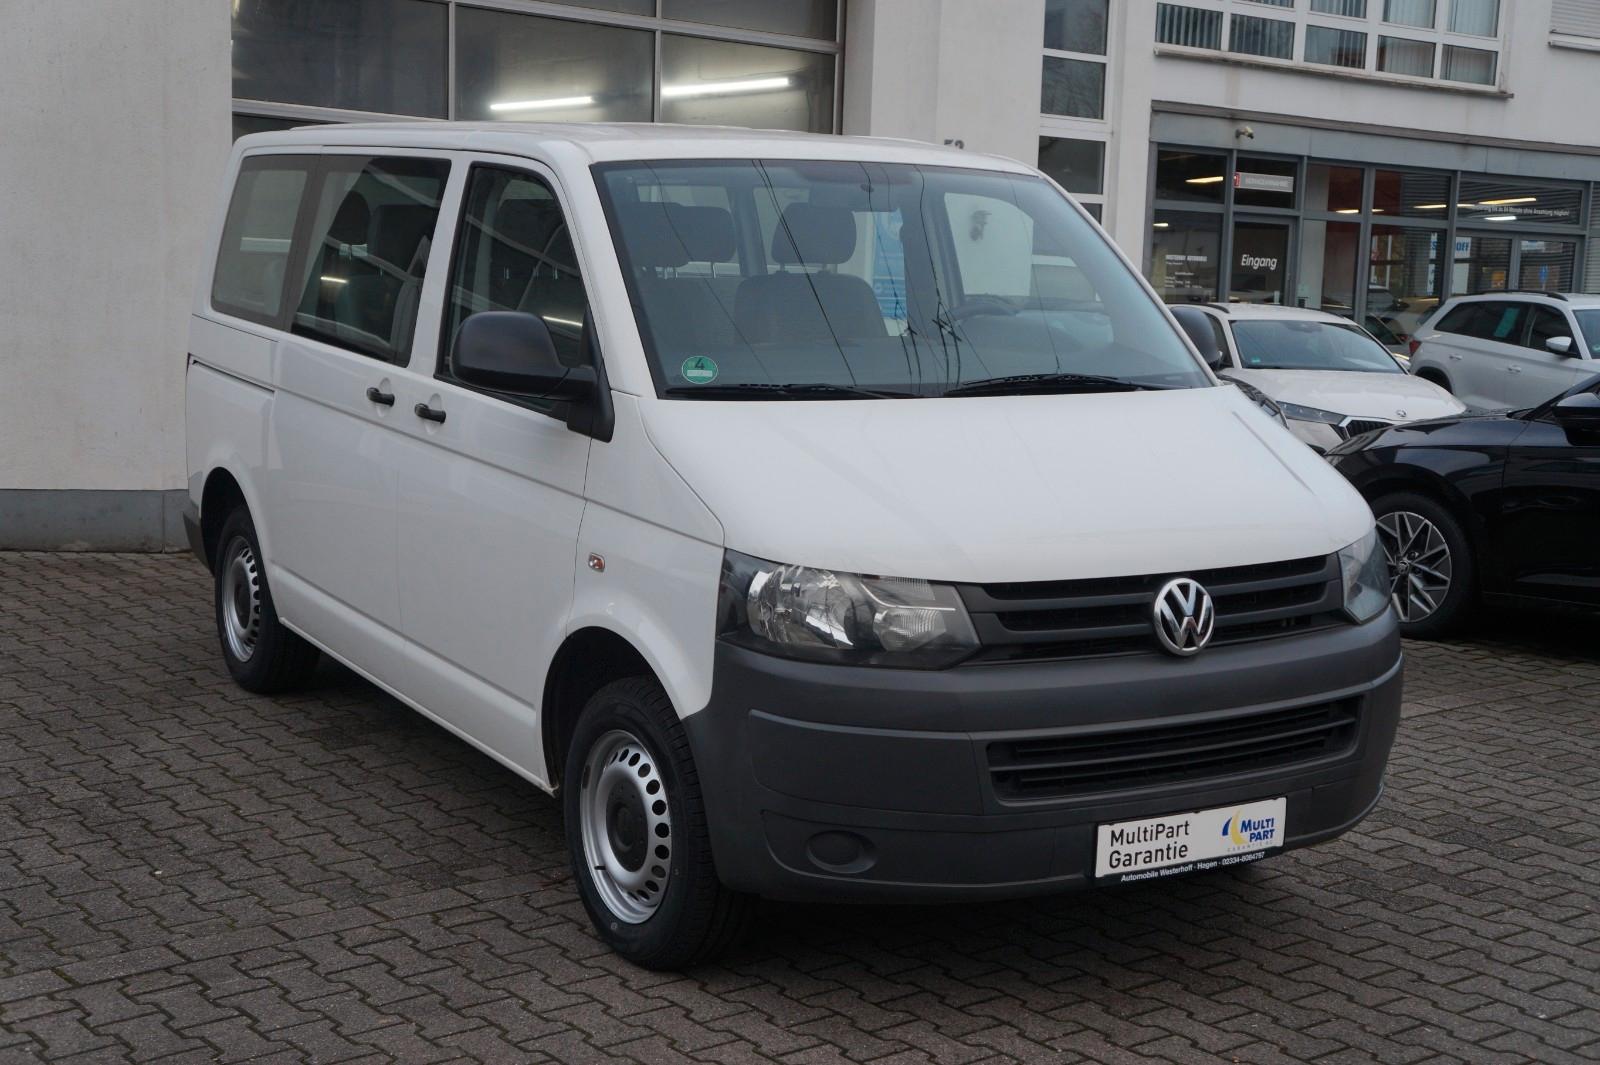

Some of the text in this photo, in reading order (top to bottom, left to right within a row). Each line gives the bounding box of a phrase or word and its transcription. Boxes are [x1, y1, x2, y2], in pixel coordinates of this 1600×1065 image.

[1241, 254, 1278, 270] Eingang
[1157, 580, 1212, 652] VW
[1110, 820, 1190, 847] MultiPart
[1240, 817, 1275, 833] MULTI
[1249, 829, 1276, 843] PART
[1109, 842, 1189, 869] Garantie
[1120, 870, 1159, 882] Automobile
[1160, 864, 1194, 877] Westerhoff
[1197, 860, 1218, 870] Hagen
